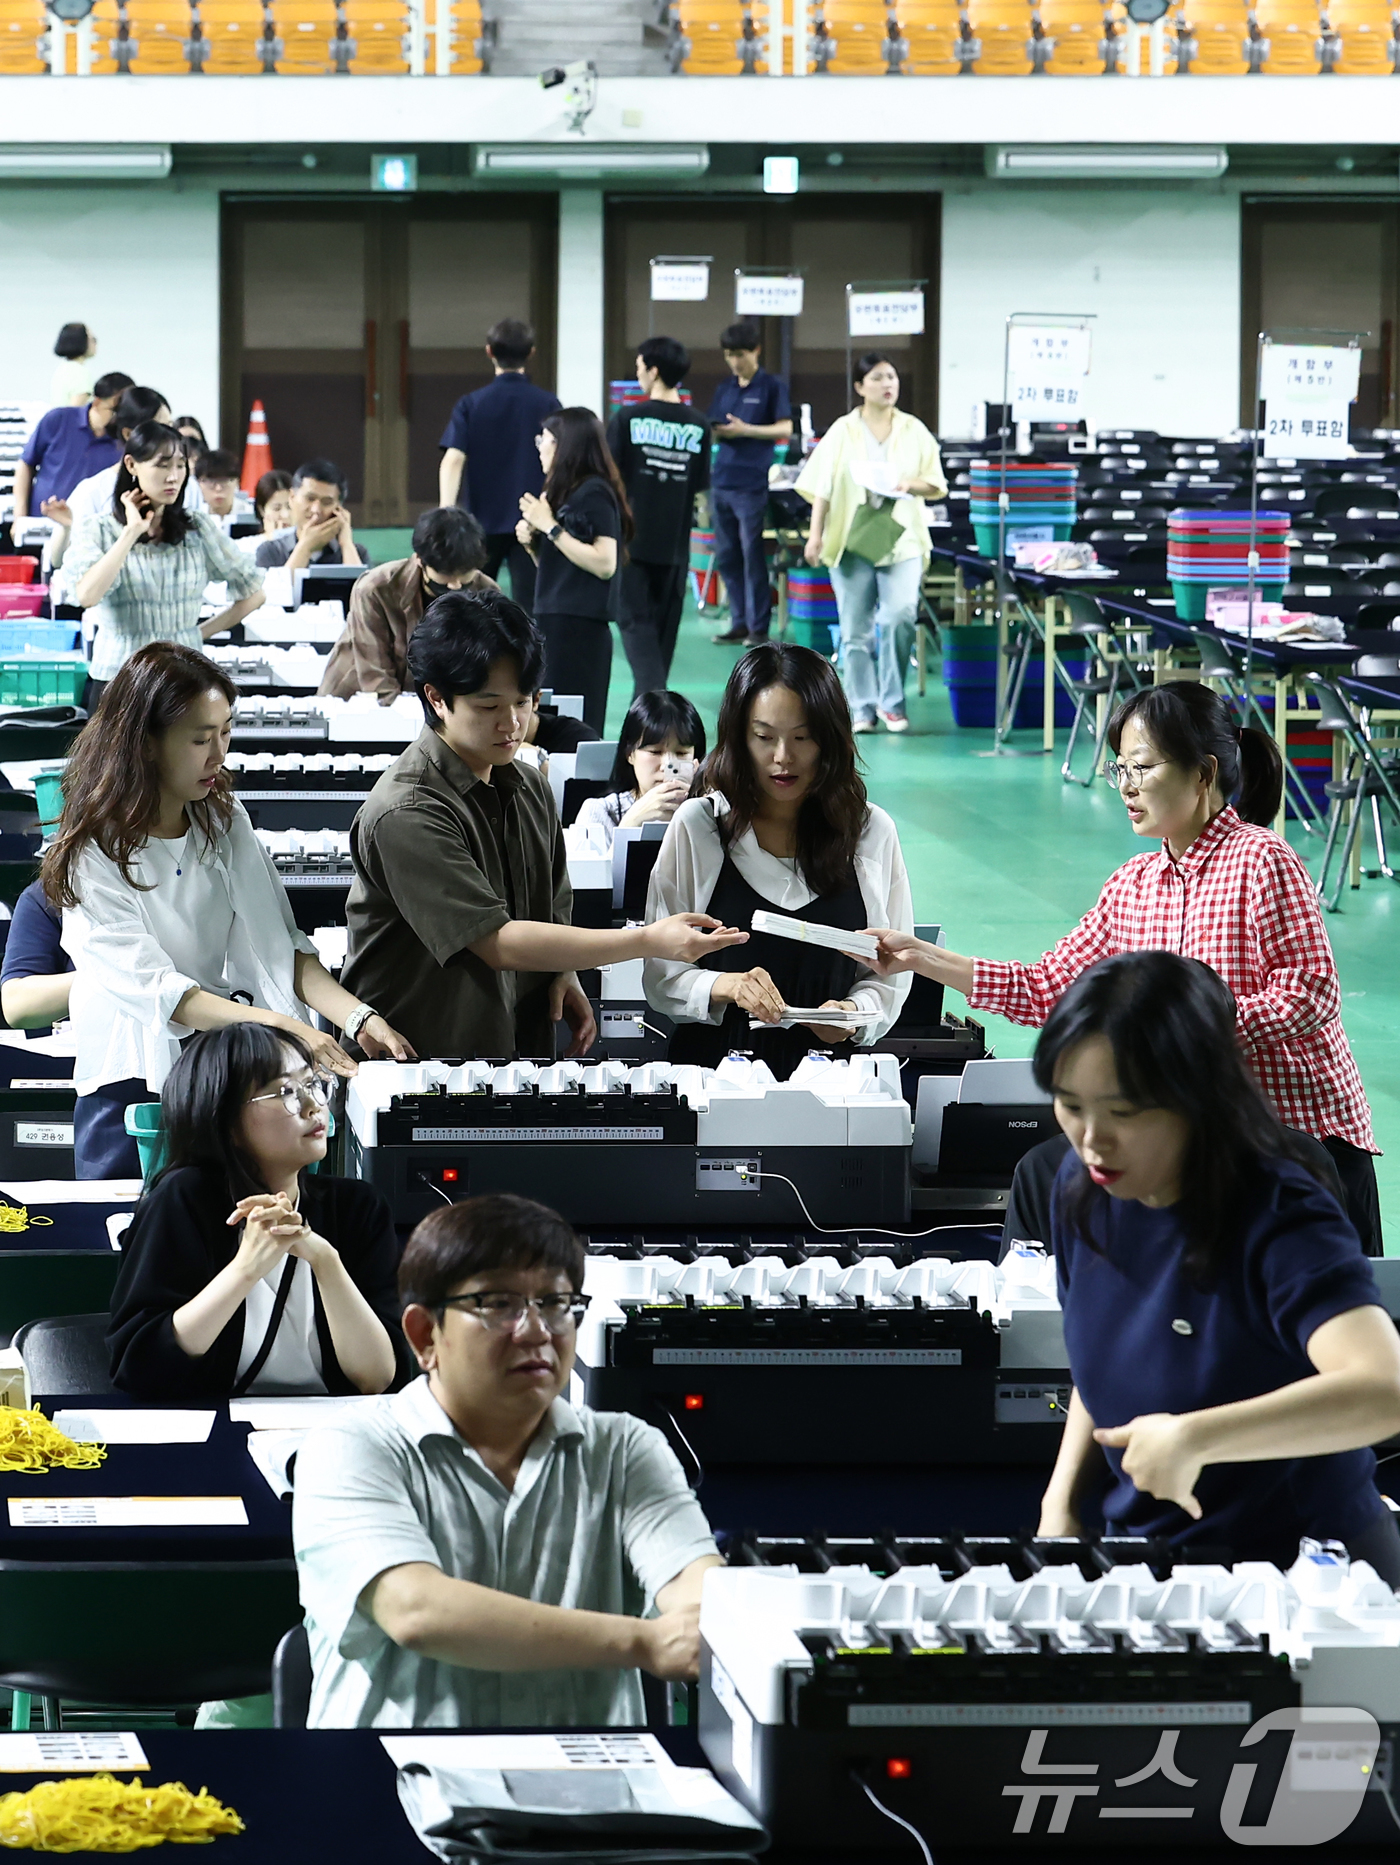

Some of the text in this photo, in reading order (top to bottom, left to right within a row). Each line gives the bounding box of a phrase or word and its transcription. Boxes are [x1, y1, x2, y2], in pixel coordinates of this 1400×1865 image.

[1269, 419, 1344, 438] 2차 투표함
[26, 1132, 38, 1140] 429
